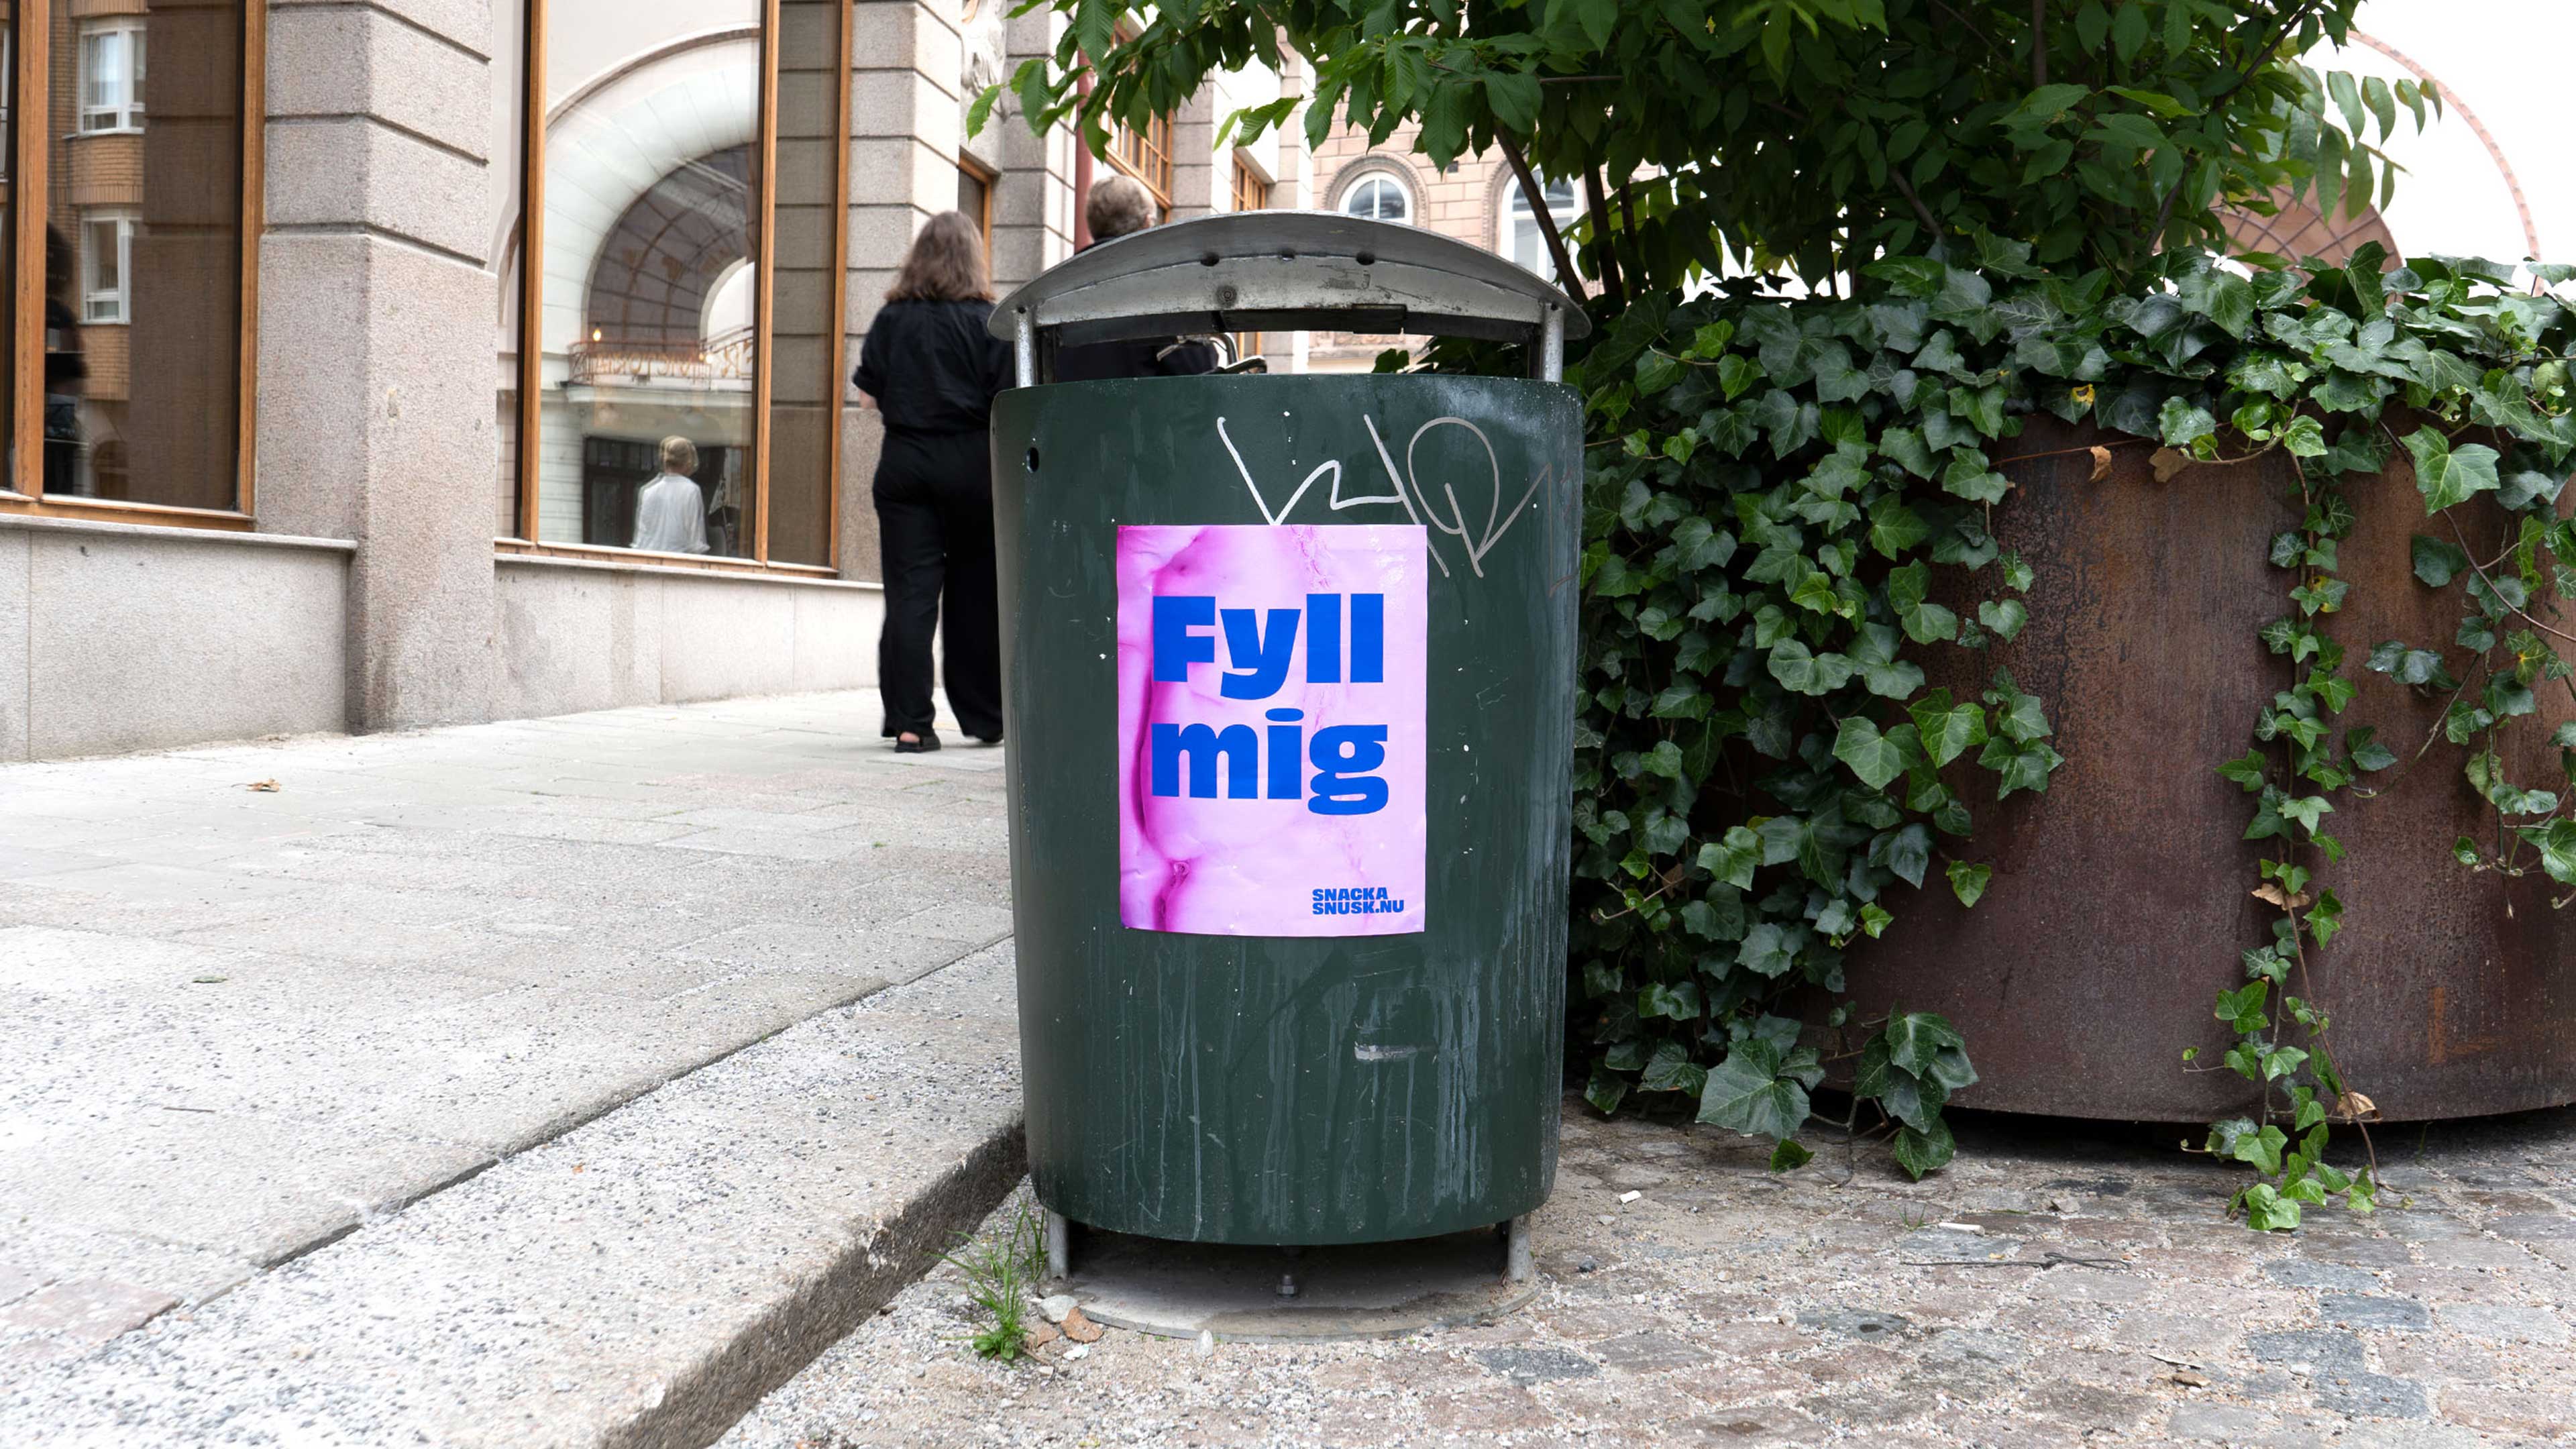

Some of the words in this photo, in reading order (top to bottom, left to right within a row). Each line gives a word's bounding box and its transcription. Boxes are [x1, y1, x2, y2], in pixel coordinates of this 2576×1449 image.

[1152, 594, 1384, 700] Fyll
[1151, 708, 1389, 816] mig
[1312, 887, 1388, 902] SNACKA
[1312, 900, 1404, 915] SNUSK.NU
